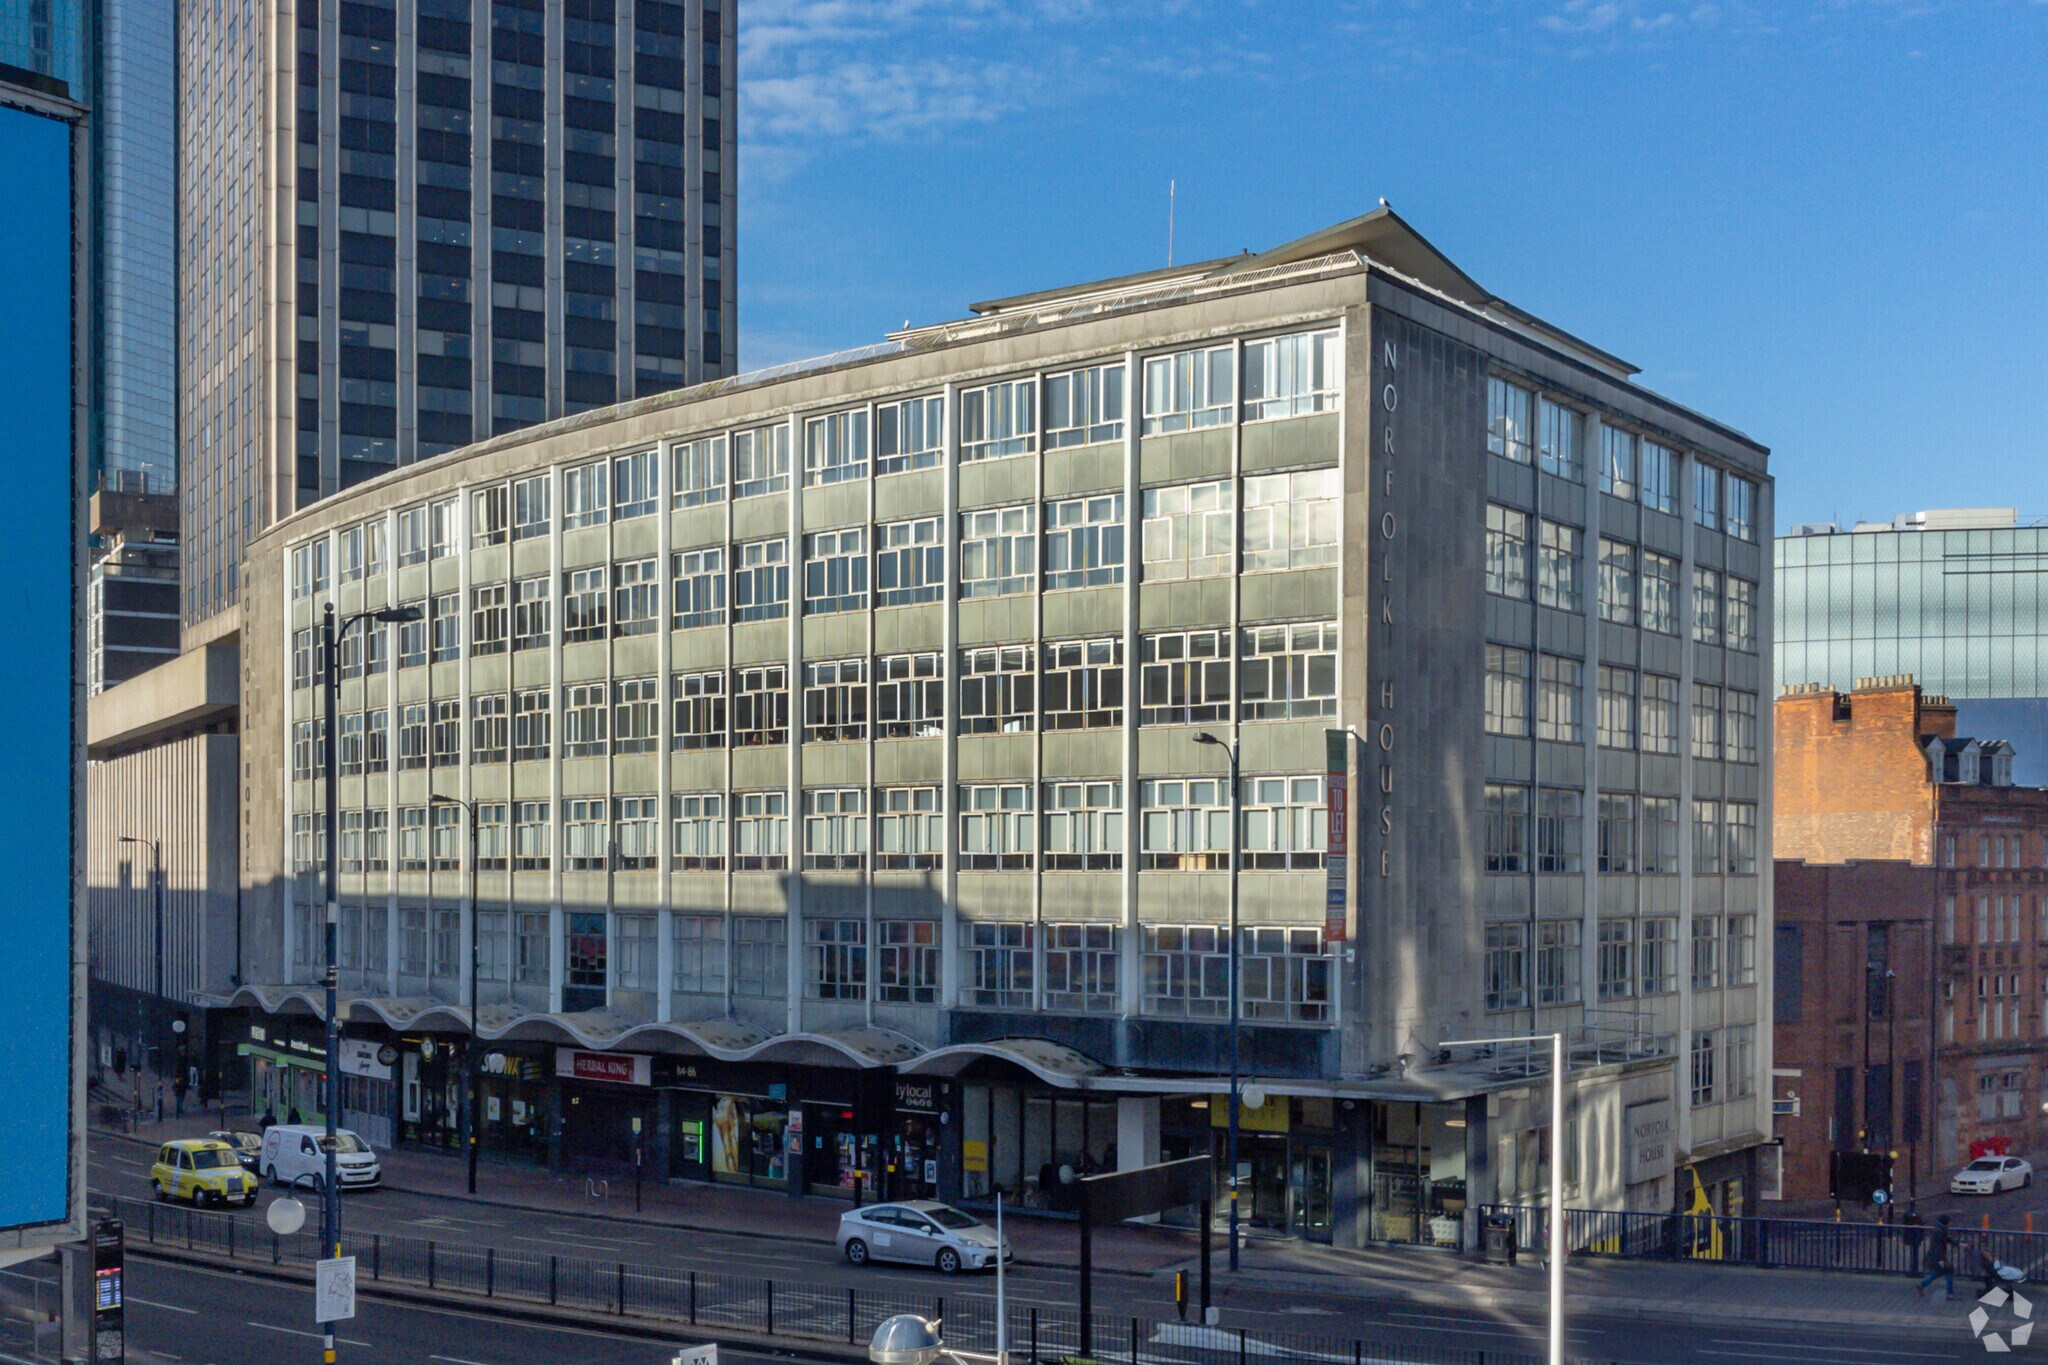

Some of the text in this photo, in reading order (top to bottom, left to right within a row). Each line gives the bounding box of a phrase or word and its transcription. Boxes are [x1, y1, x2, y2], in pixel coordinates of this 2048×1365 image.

[1380, 340, 1398, 877] NORFOLK HOUSE
[1332, 788, 1343, 811] TO
[1331, 811, 1344, 834] LET
[576, 1058, 606, 1073] HERBAL
[608, 1062, 628, 1075] KING
[1634, 1118, 1670, 1138] NORFOLK
[1639, 1144, 1665, 1164] HOUSE
